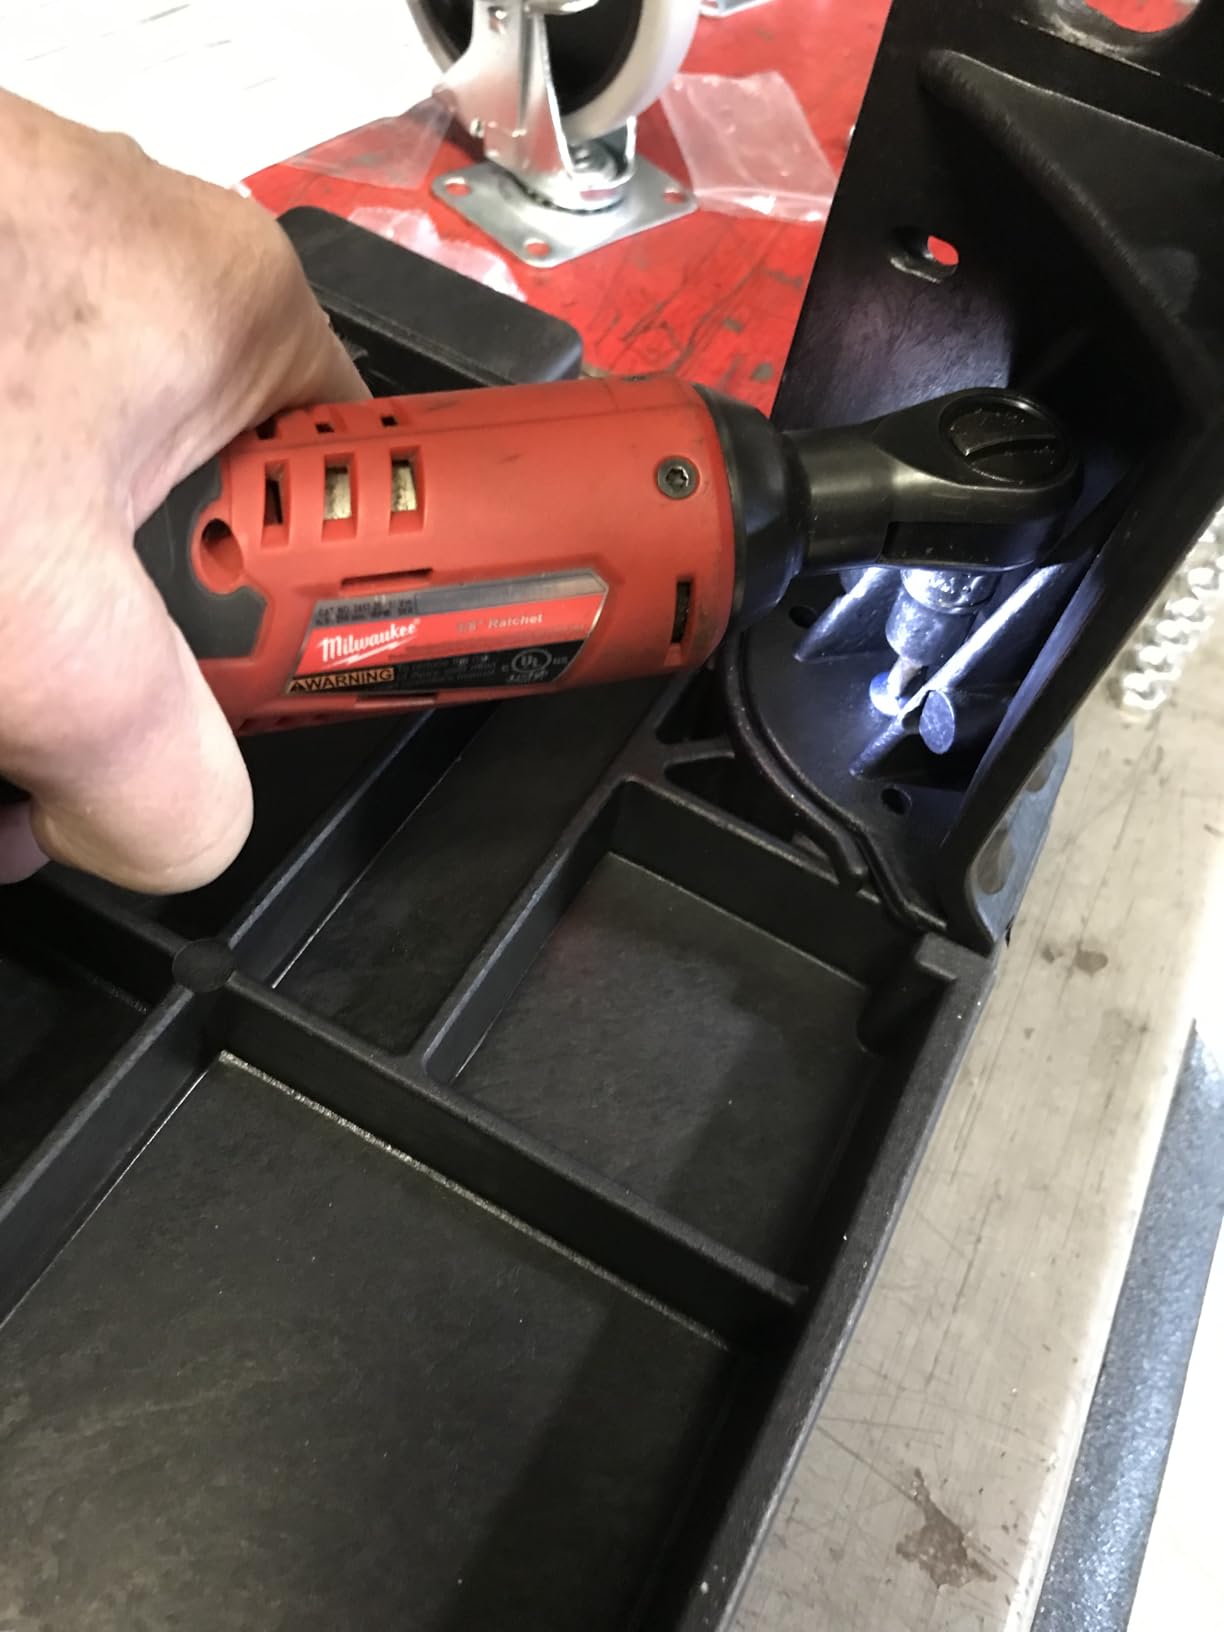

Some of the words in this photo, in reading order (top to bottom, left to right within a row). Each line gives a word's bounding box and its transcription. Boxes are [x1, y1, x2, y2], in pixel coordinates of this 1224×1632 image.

[488, 613, 543, 629] Ratchet
[316, 623, 416, 662] Milwaukee
[304, 669, 393, 690] WARNING
